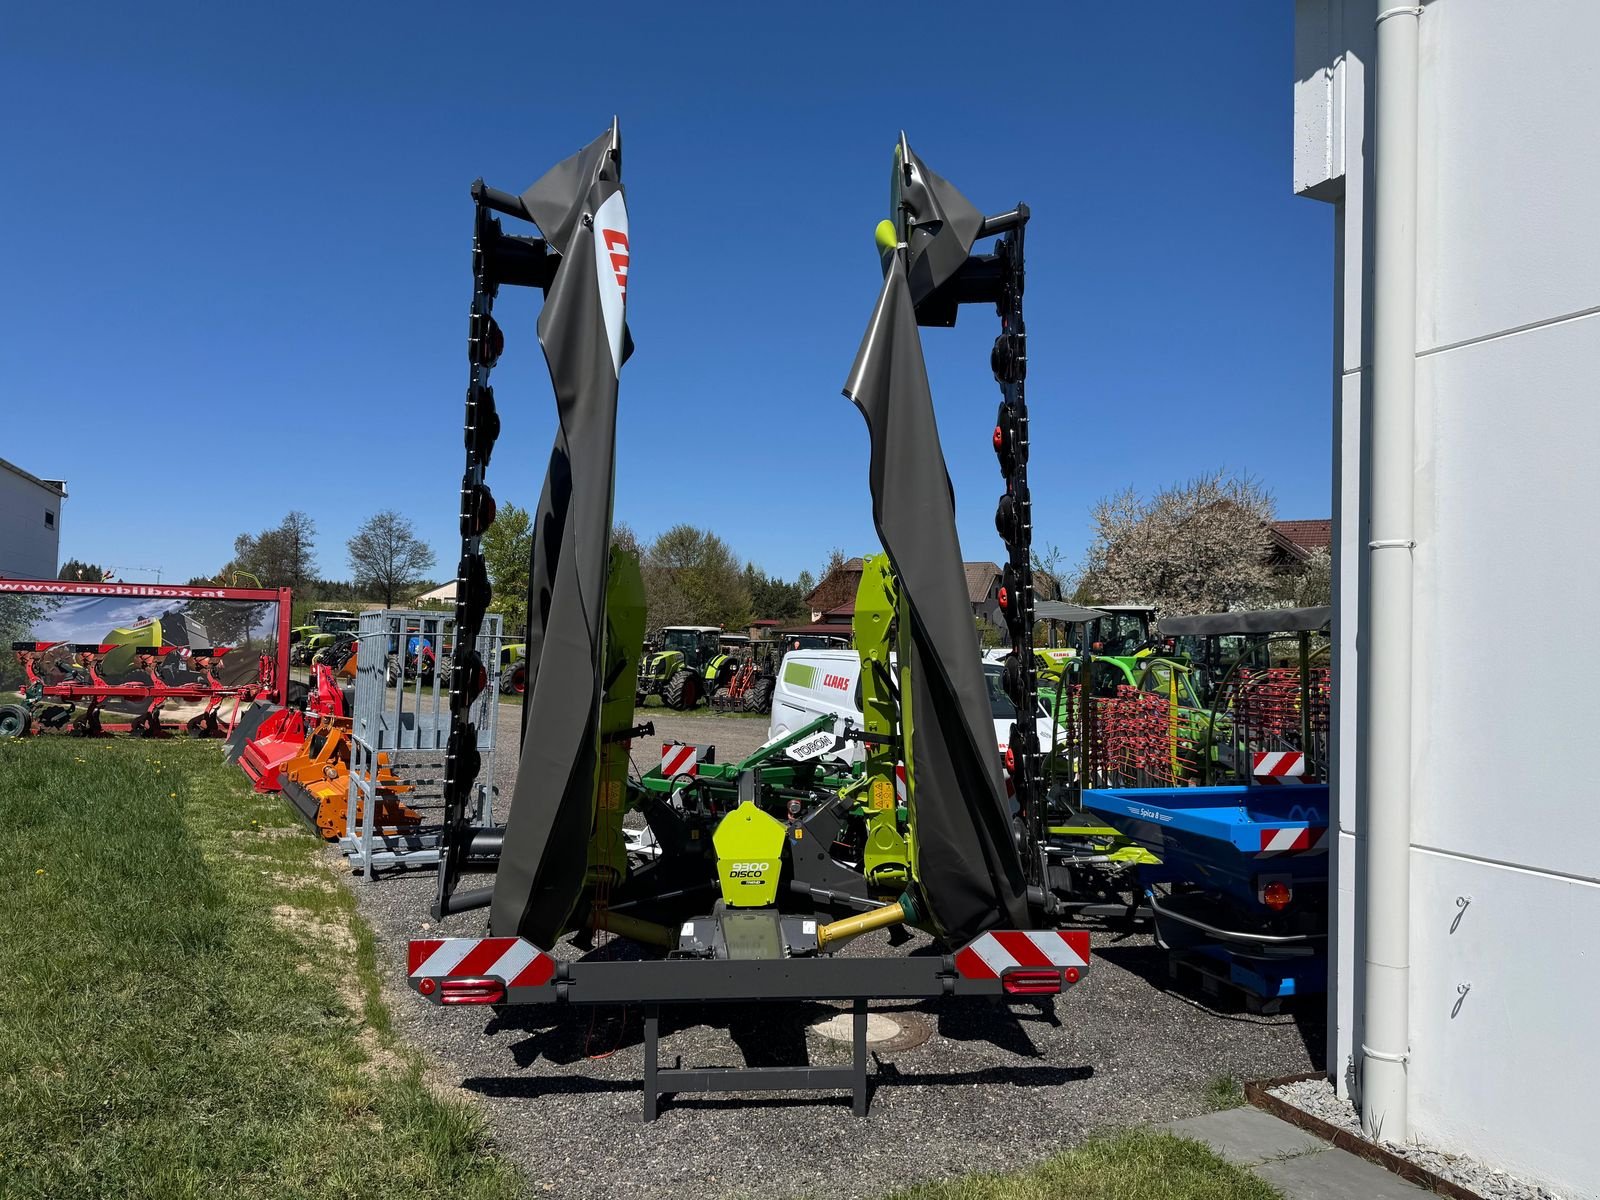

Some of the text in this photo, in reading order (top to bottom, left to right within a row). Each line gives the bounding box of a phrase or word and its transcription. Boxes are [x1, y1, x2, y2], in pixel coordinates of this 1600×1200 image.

[0, 583, 226, 598] www.mobilbox.at
[823, 673, 850, 691] CLAAS
[793, 735, 833, 758] TORON
[1140, 808, 1155, 818] Spica
[731, 863, 769, 871] 9300
